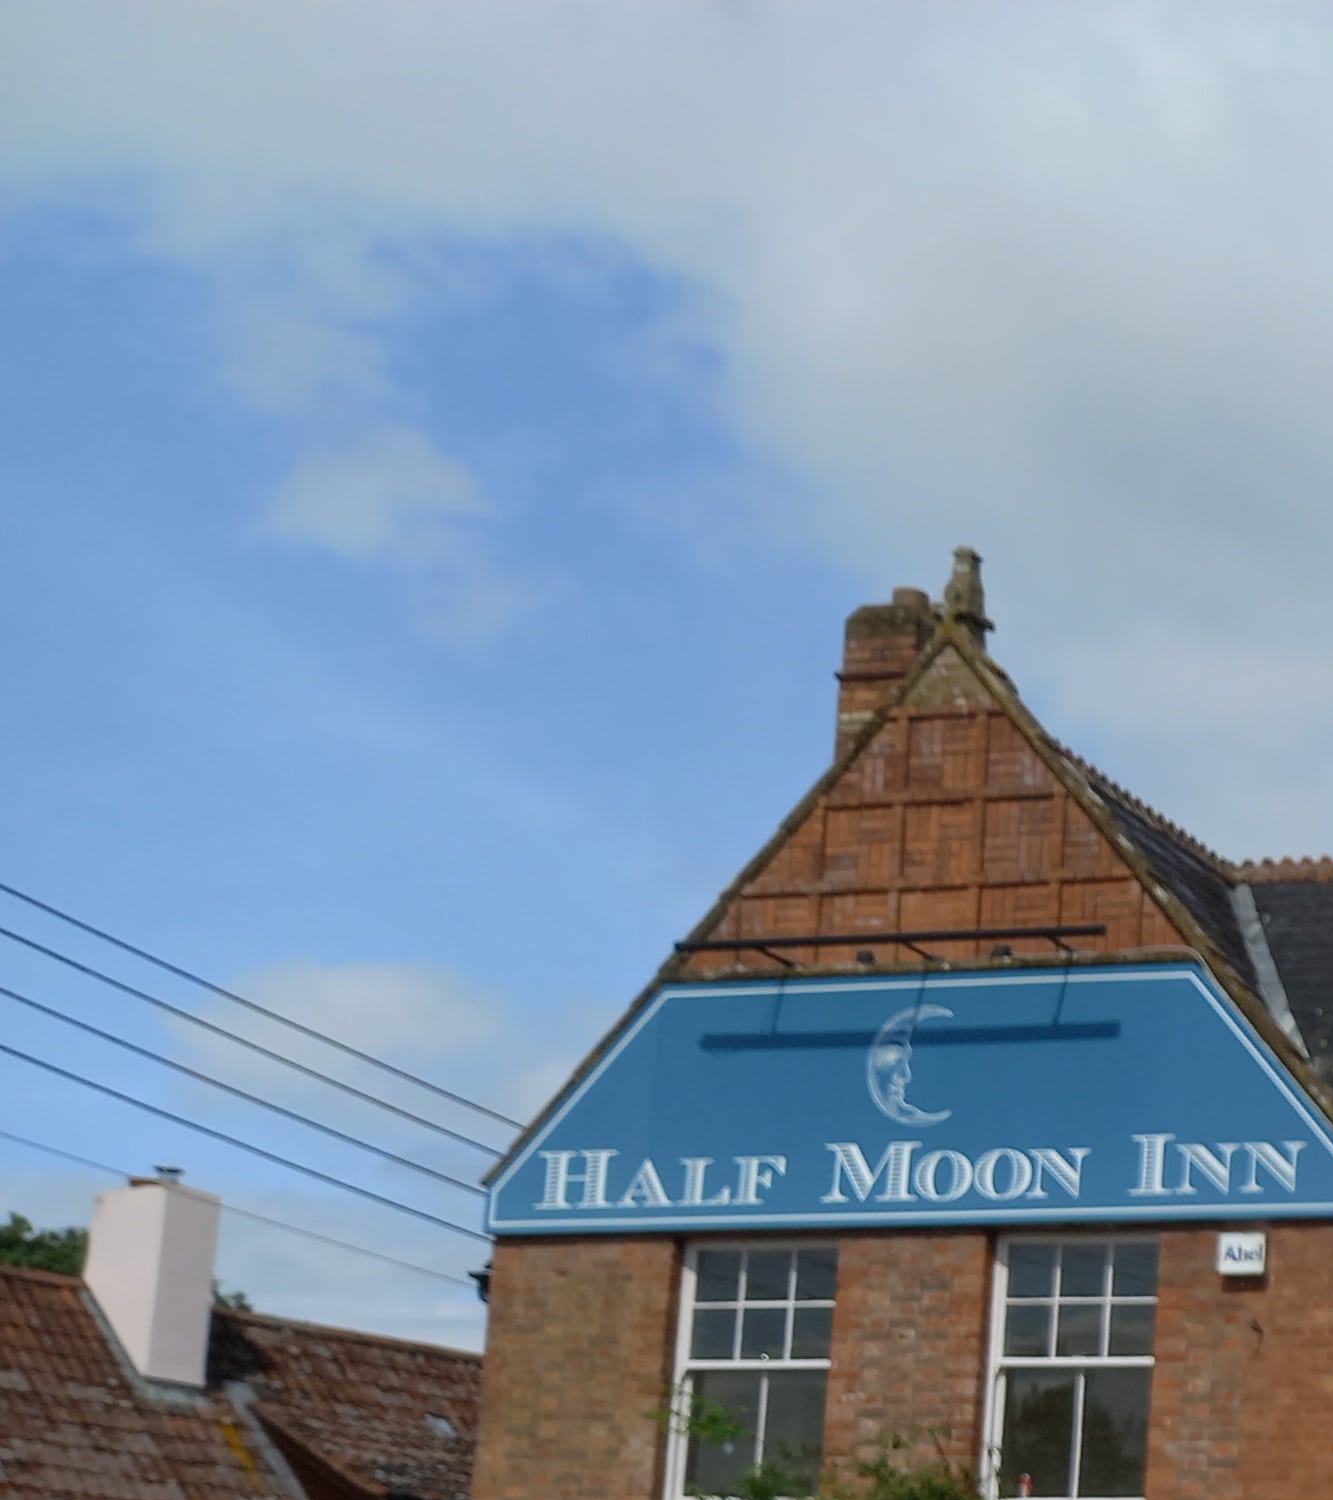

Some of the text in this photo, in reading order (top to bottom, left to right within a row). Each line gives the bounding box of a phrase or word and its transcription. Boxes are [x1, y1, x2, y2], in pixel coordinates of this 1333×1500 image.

[532, 1132, 1309, 1211] HALF MOON INN
